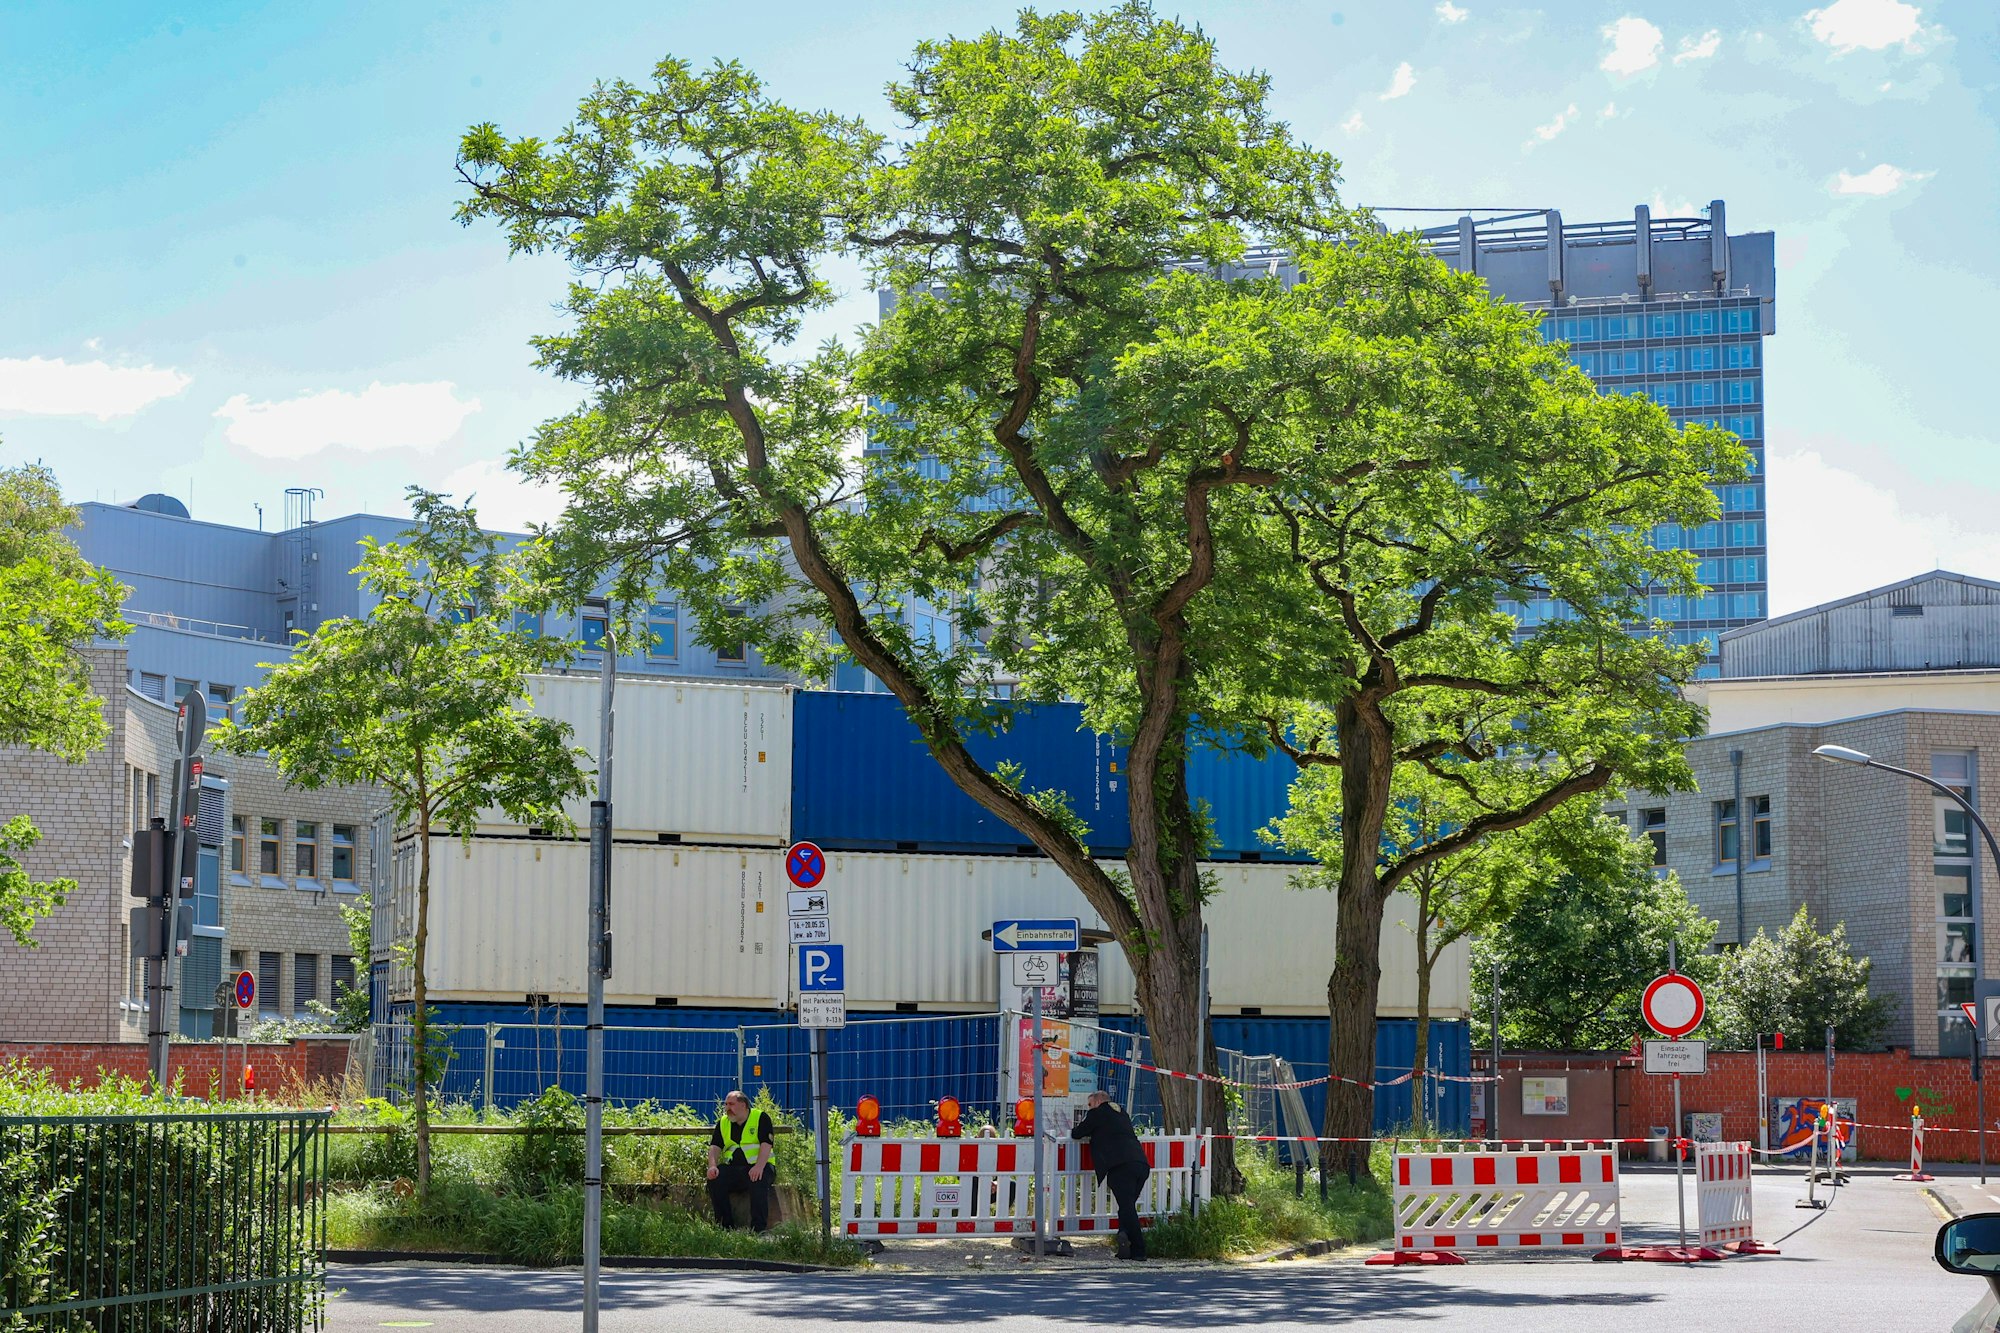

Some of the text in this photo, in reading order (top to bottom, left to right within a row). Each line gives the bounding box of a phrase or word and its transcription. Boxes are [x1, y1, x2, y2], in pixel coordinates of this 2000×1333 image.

[806, 930, 813, 938] ab
[1016, 931, 1073, 939] Einbahnstraße
[802, 1016, 810, 1024] Sa
[1022, 1028, 1068, 1040] MSIC!
[937, 1193, 956, 1201] LOKA
